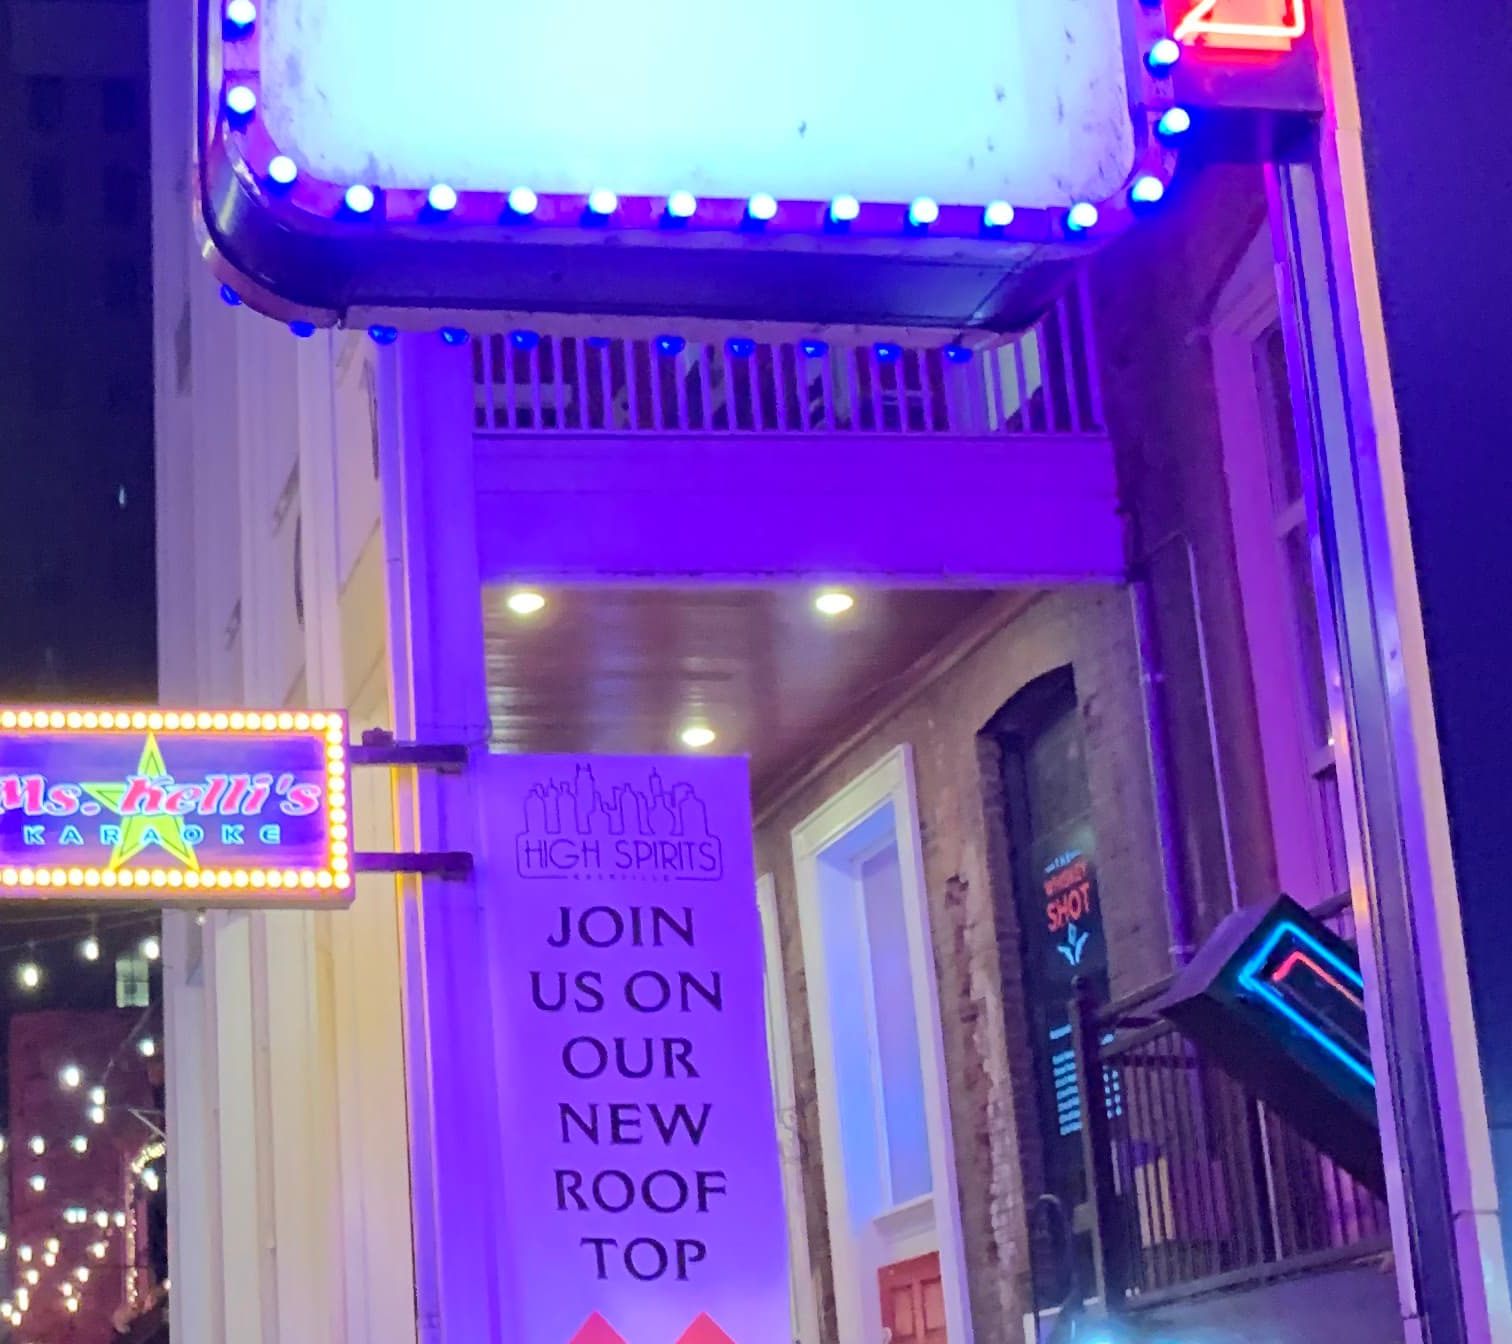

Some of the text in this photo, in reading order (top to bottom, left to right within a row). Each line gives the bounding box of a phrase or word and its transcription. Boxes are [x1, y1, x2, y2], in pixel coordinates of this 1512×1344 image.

[119, 773, 321, 816] Kelli's
[24, 823, 282, 846] KARAOKE
[525, 839, 717, 871] HIGH SPIRITS
[546, 905, 696, 949] JOIN
[1047, 882, 1089, 932] SHOT
[529, 970, 723, 1013] US ON
[562, 1035, 701, 1079] OUR
[558, 1102, 713, 1145] NEW
[554, 1169, 728, 1213] ROOF
[580, 1237, 707, 1282] TOP
